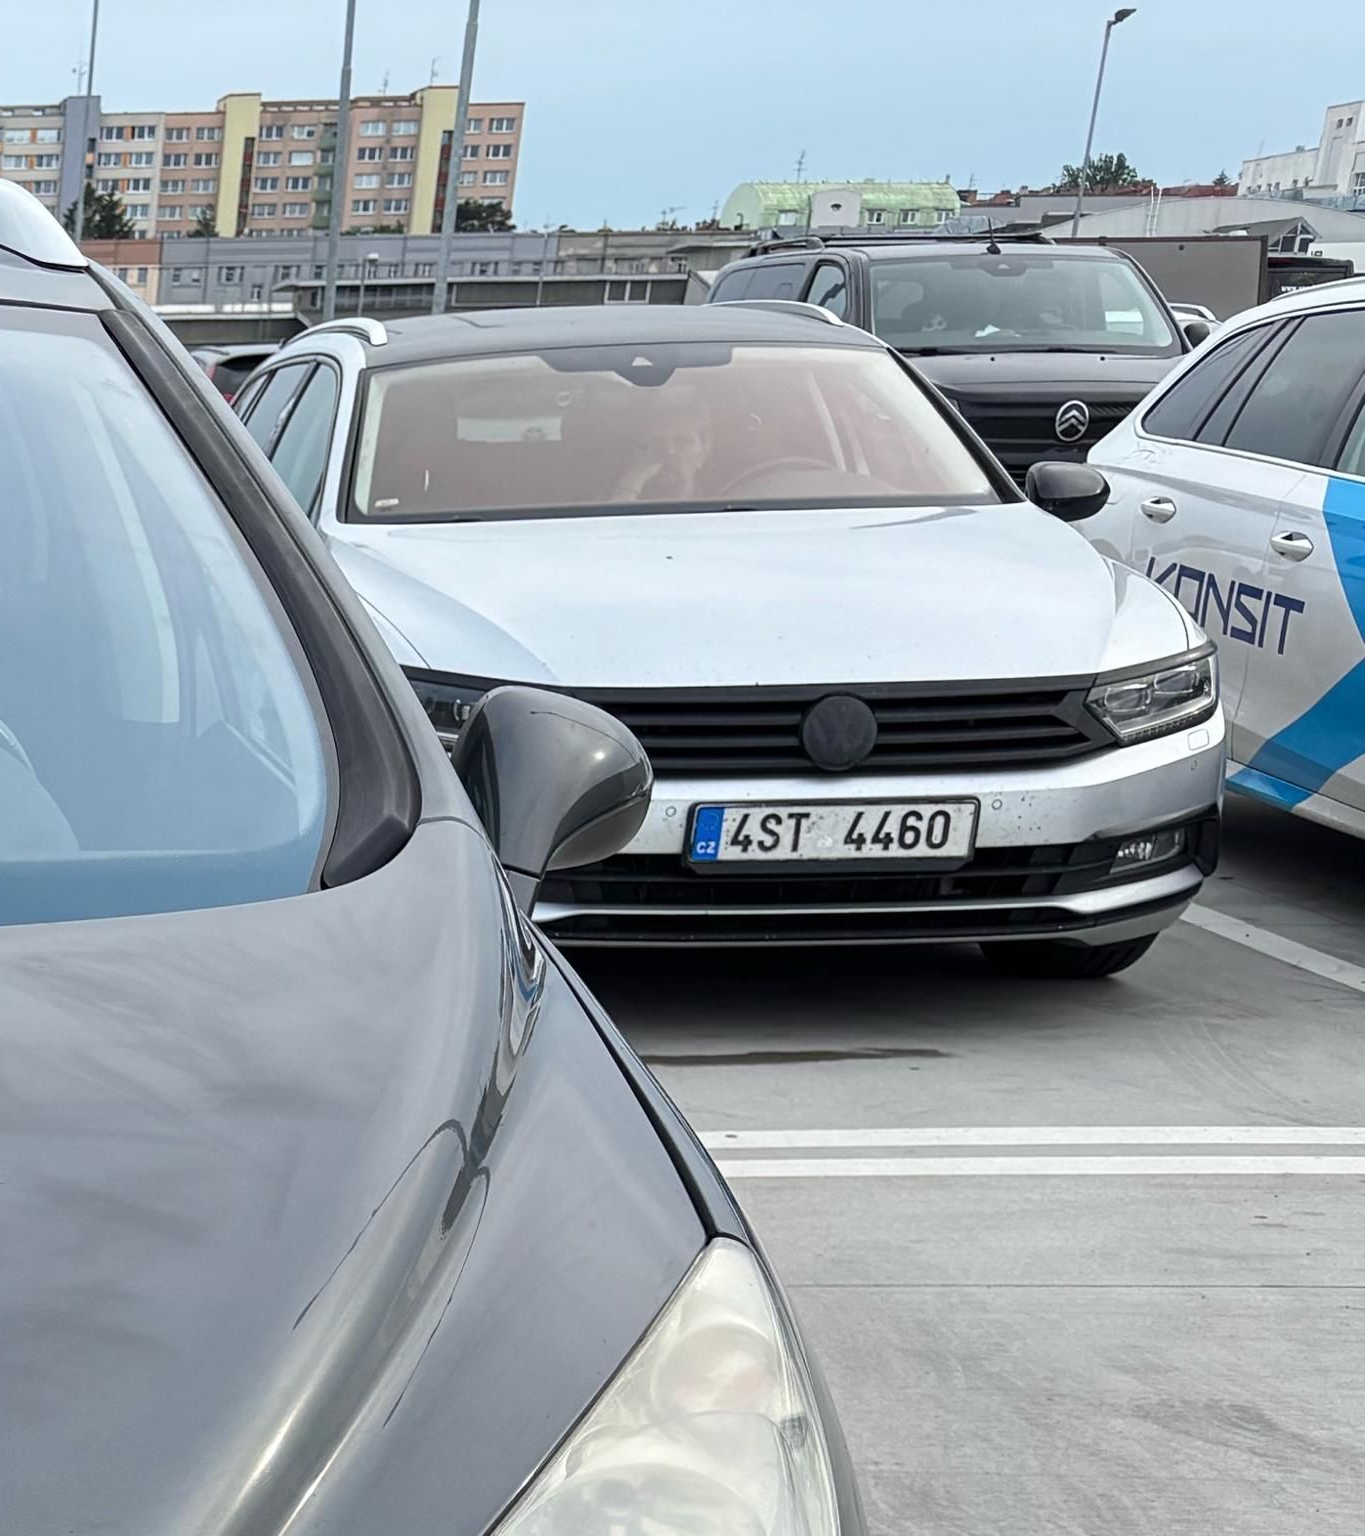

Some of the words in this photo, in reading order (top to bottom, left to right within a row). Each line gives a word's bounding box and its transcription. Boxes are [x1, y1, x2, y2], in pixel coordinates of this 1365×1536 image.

[696, 840, 716, 854] CZ
[730, 812, 811, 853] 4ST
[843, 809, 951, 851] 4460
